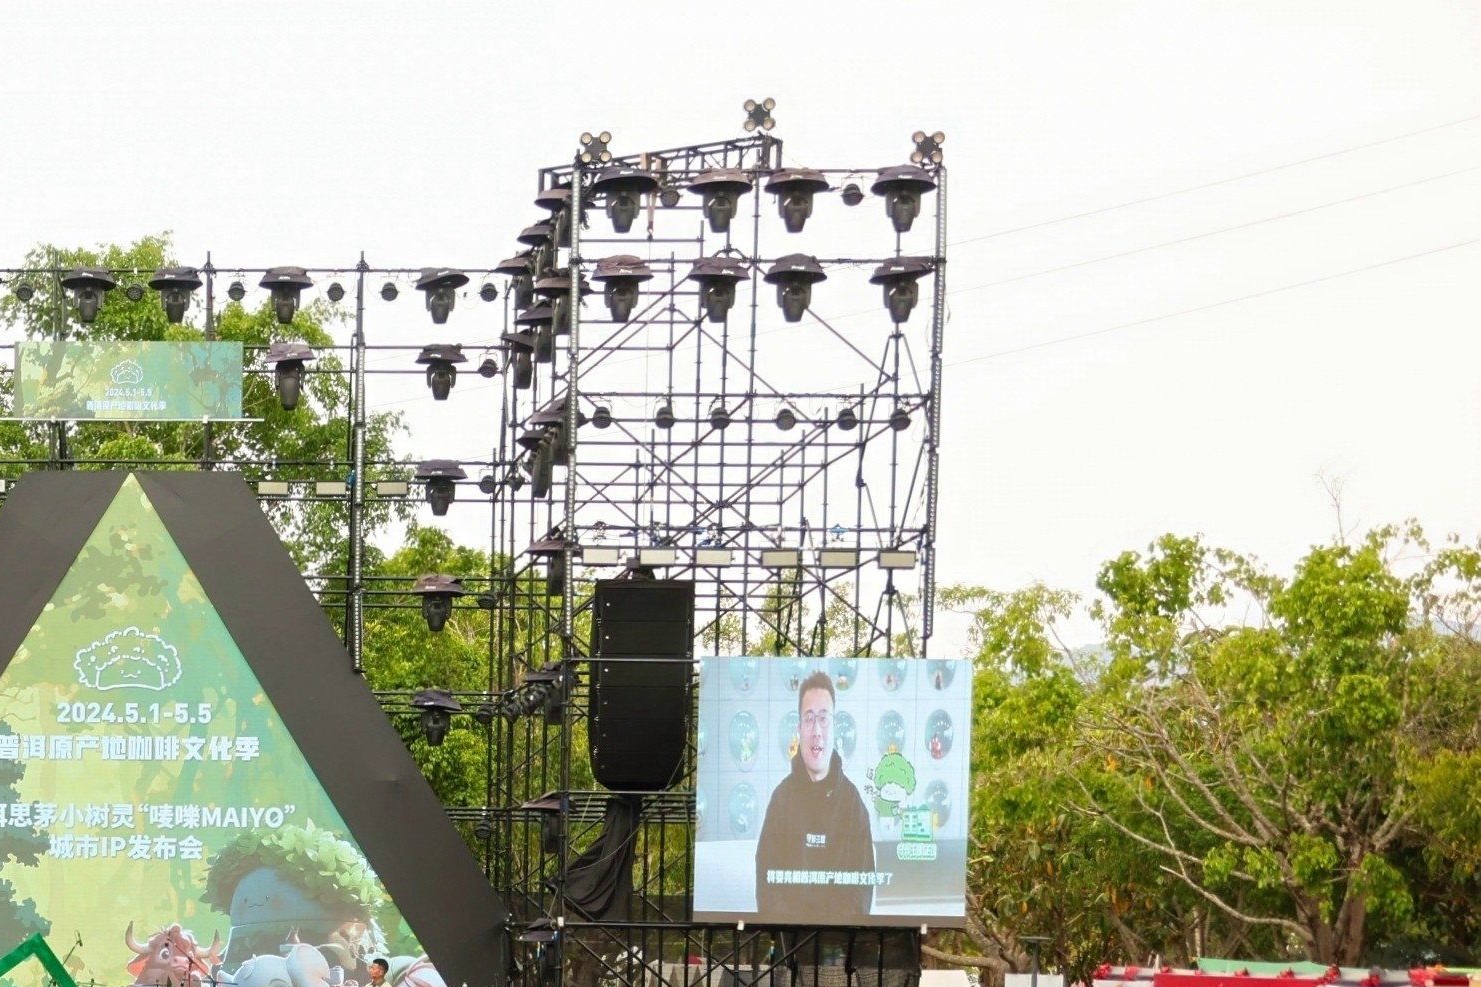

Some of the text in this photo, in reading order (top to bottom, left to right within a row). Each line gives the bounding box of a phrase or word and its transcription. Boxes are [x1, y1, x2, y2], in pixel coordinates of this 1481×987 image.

[57, 702, 212, 724] 2024.5.1-5.5
[49, 836, 204, 861] 城市IP发布会
